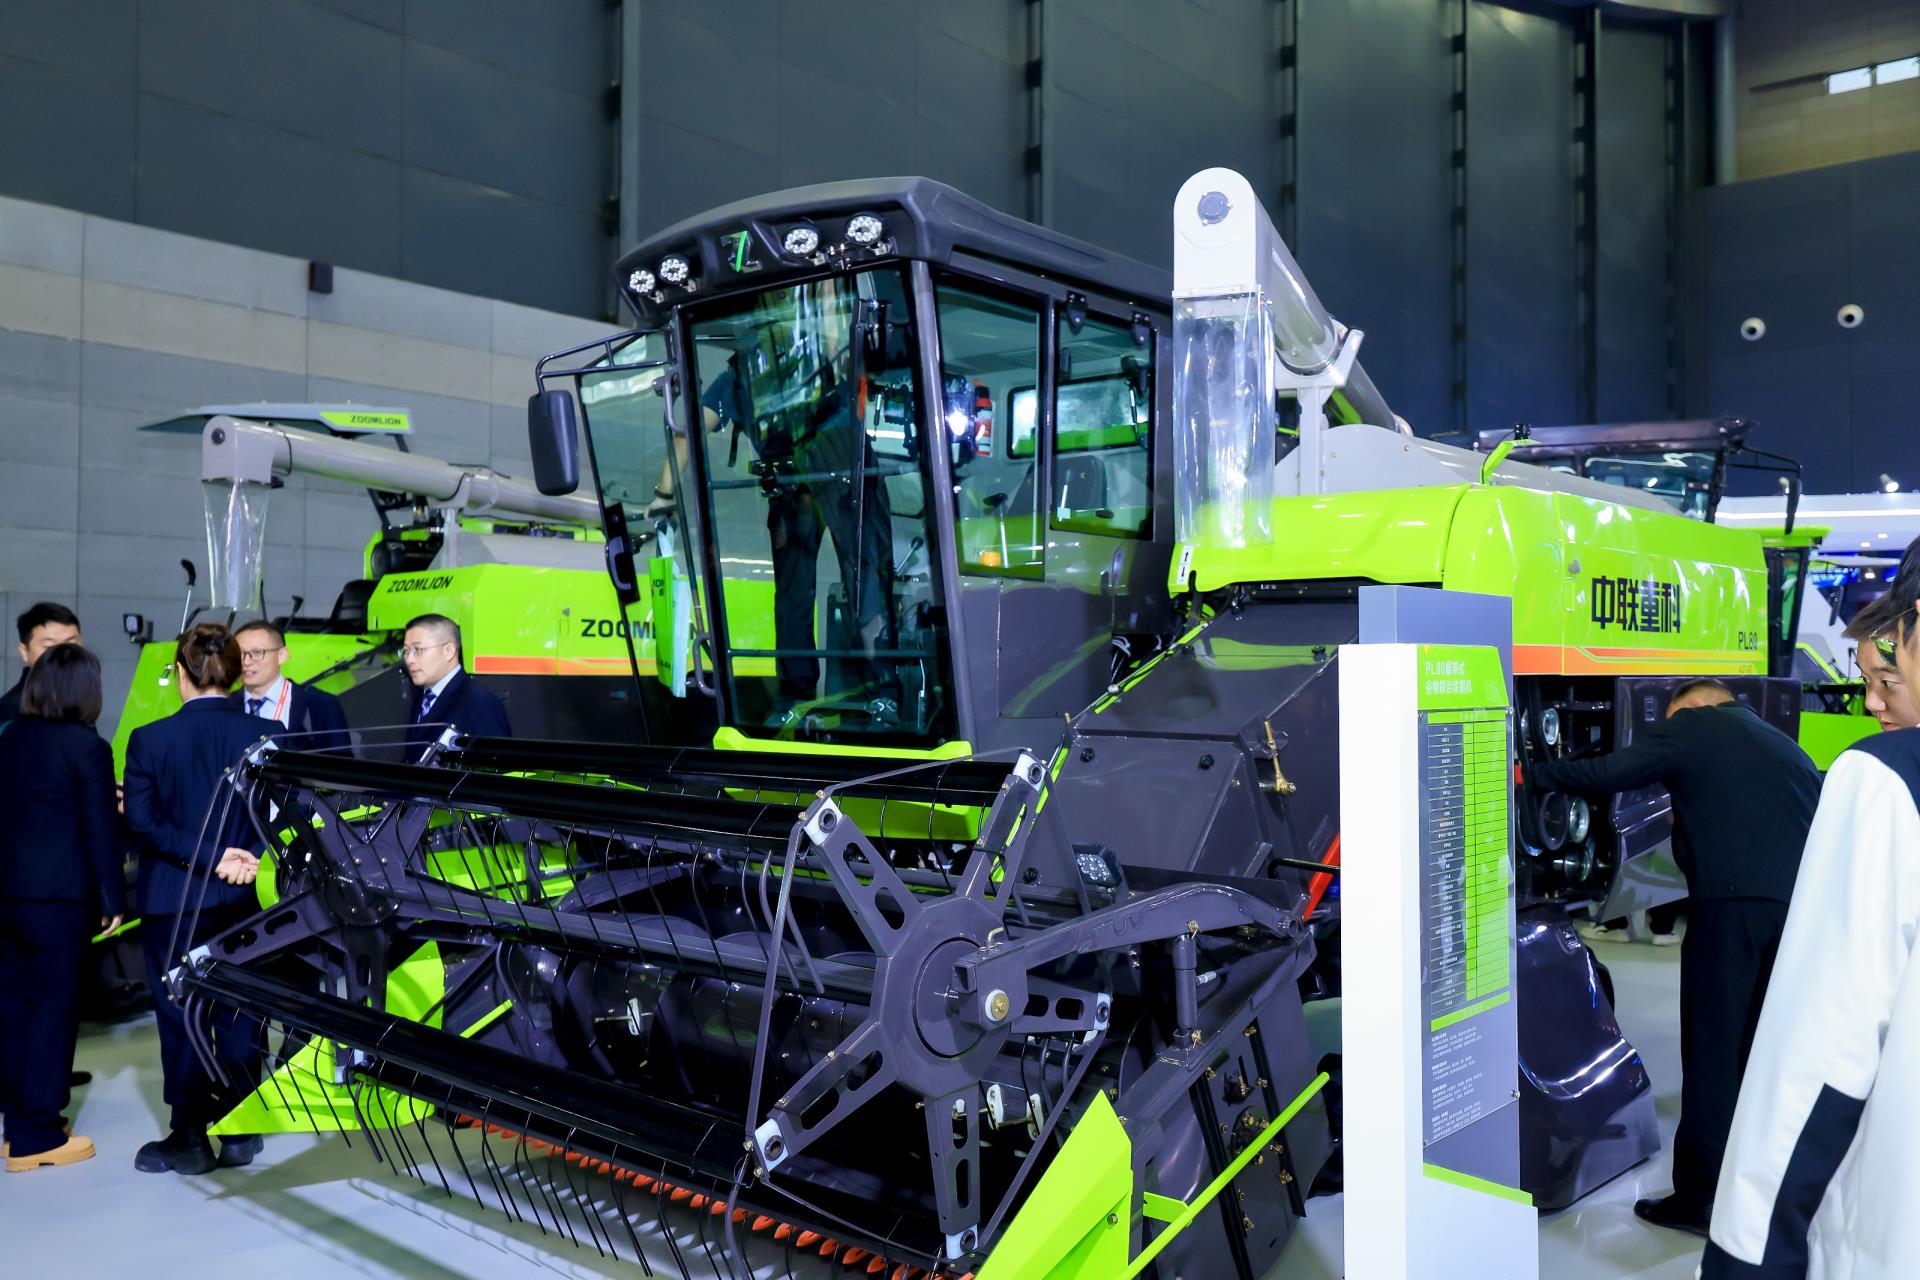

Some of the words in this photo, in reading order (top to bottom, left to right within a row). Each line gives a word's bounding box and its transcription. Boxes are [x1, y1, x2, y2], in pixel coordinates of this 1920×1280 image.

[351, 415, 401, 425] ZOOMLION
[386, 575, 454, 593] ZOOMLION
[1591, 575, 1681, 634] 中联重科
[1738, 631, 1758, 650] PL80
